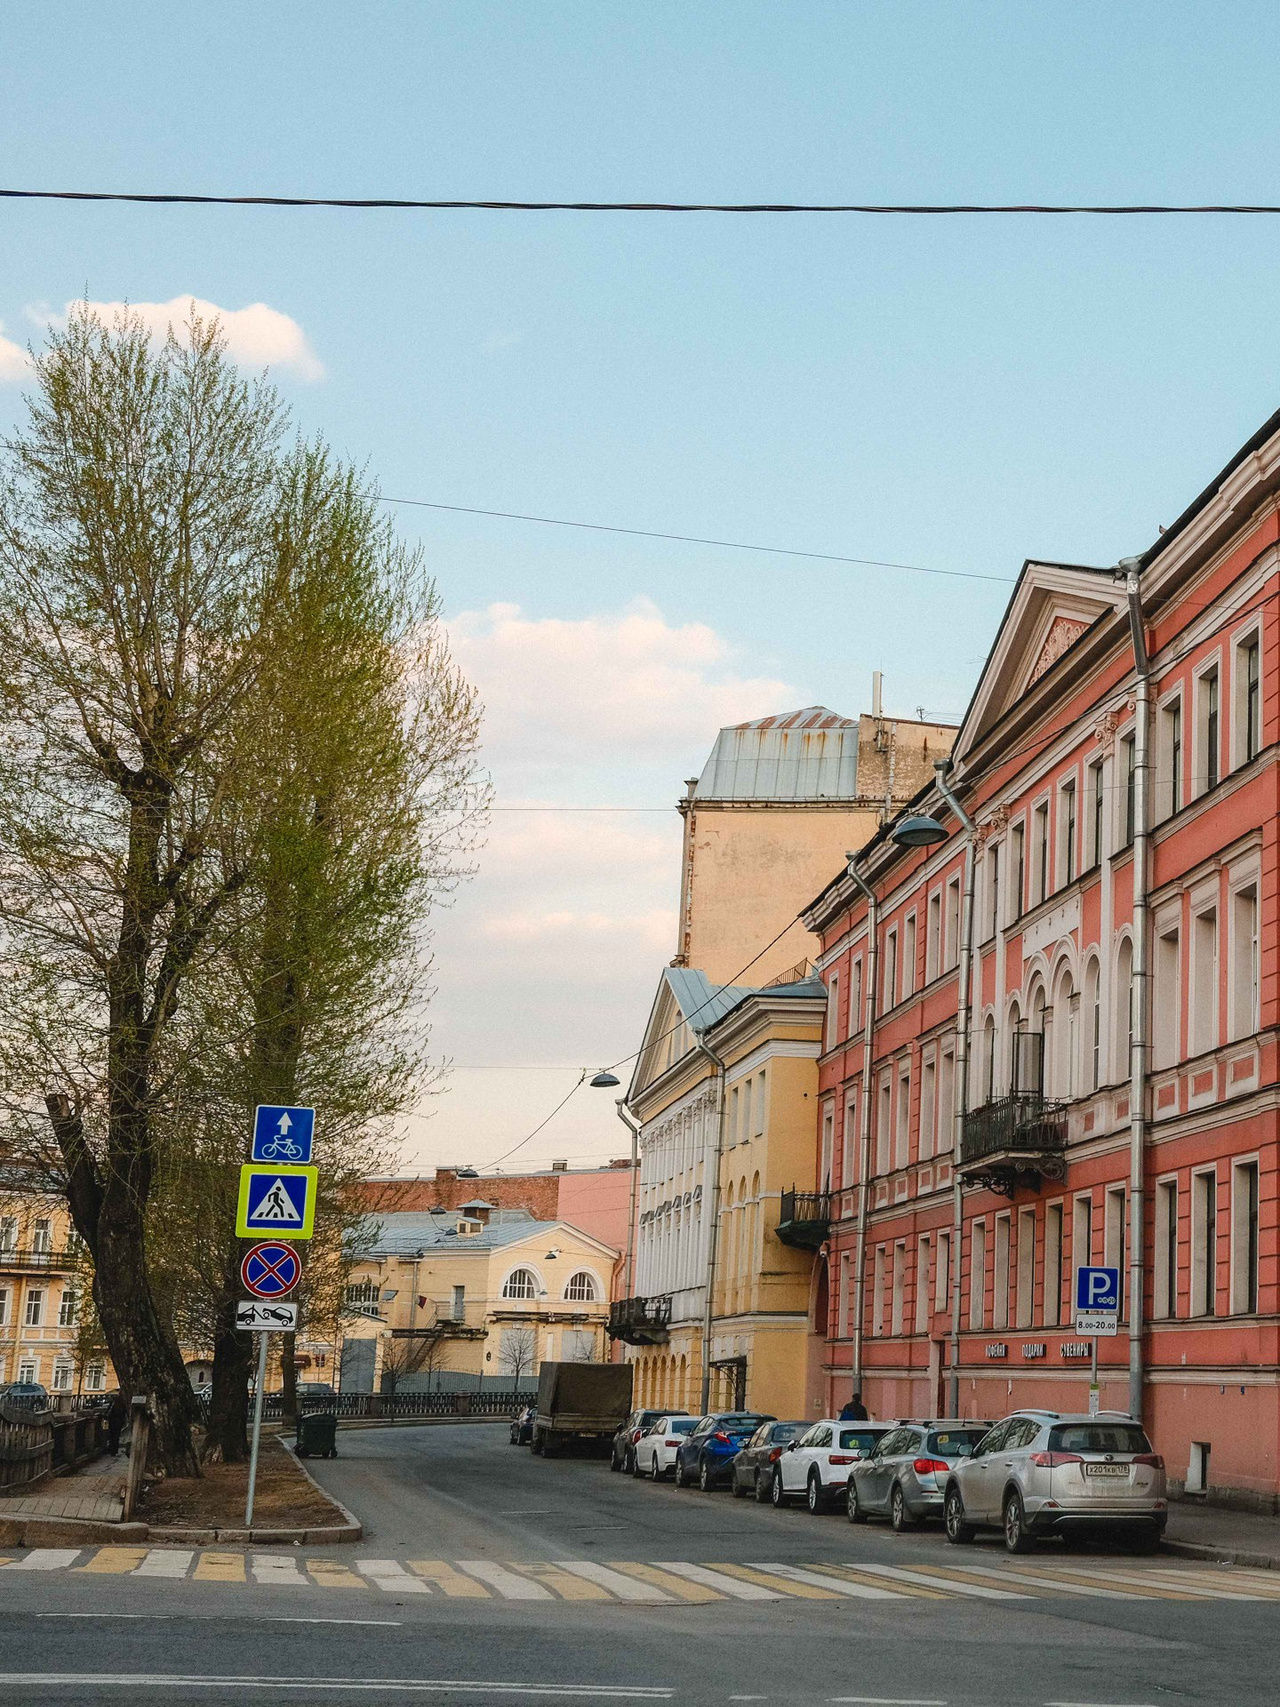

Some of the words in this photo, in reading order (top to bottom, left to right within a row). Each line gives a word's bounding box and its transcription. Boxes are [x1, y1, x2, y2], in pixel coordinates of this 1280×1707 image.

[1089, 1272, 1111, 1305] P
[1022, 1344, 1044, 1359] ПОДАРКИ
[1060, 1343, 1089, 1357] СУВЕНИРЫ
